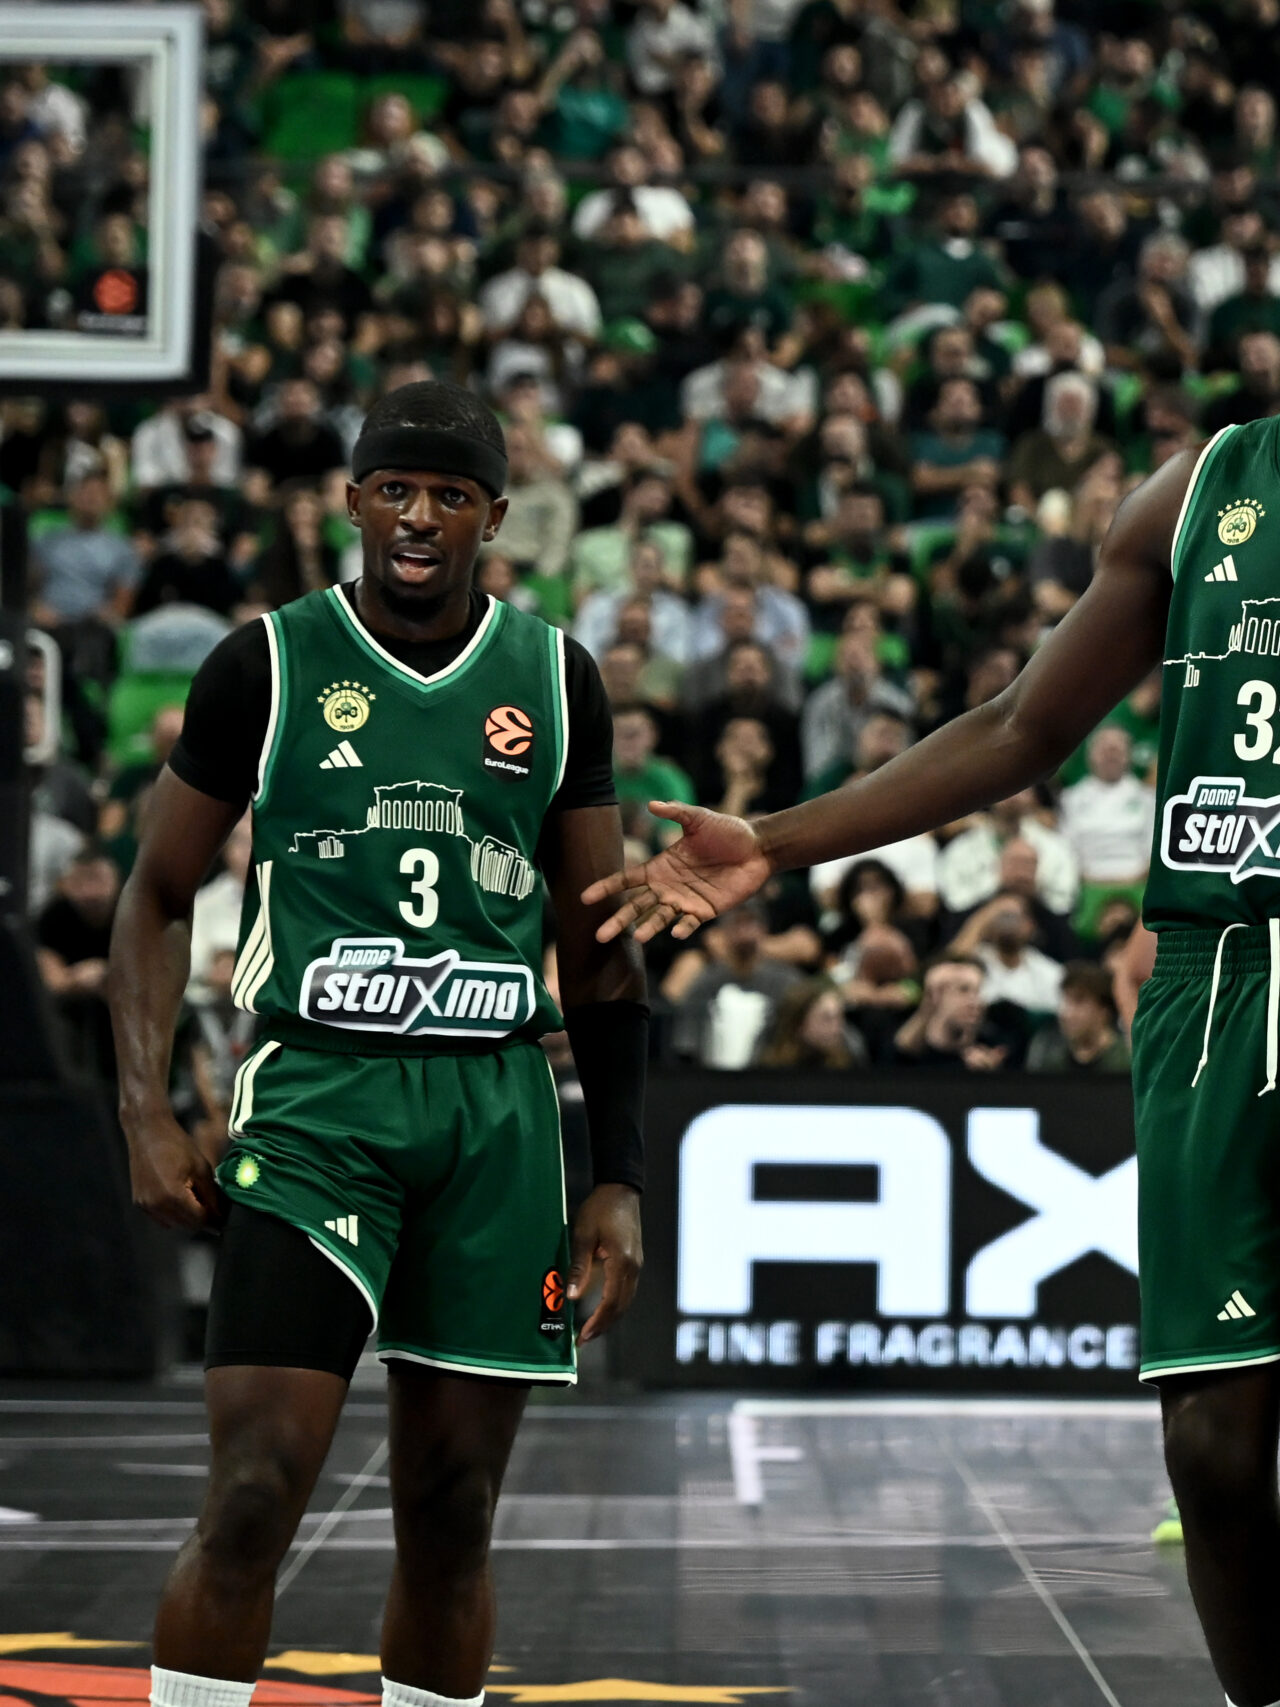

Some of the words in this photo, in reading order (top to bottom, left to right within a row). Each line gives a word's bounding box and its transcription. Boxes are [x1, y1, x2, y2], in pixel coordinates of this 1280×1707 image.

[1196, 787, 1237, 807] pame
[398, 848, 440, 928] 3
[338, 948, 392, 968] pame
[677, 1103, 1139, 1318] AX
[540, 1322, 566, 1331] ETIHAD
[676, 1321, 798, 1366] FINE
[815, 1322, 1138, 1369] FRAGRANCE
